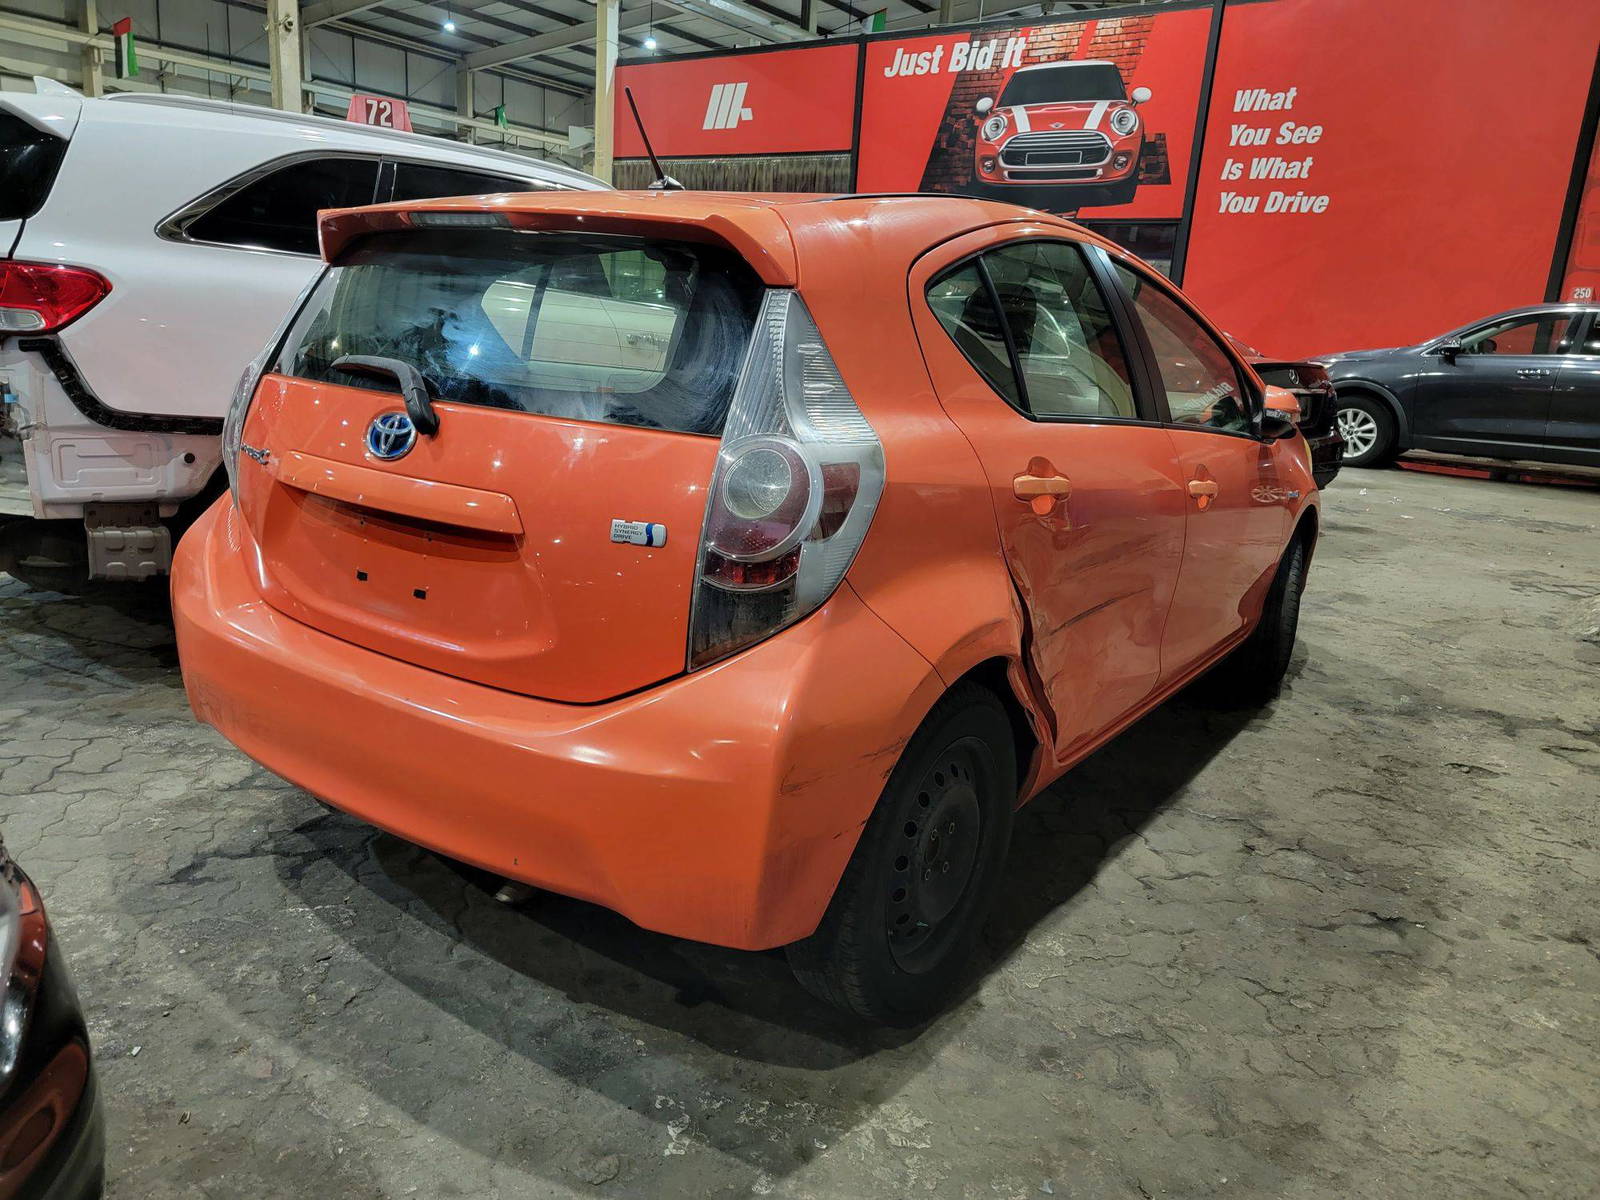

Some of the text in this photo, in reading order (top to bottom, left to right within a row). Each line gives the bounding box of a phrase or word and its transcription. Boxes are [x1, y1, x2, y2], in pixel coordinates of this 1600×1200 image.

[884, 36, 1027, 78] Just Bid It
[1233, 87, 1297, 112] What
[366, 99, 392, 127] 72
[1229, 121, 1323, 147] You See
[1220, 157, 1313, 180] Is What
[1218, 191, 1330, 213] You Drive
[1573, 287, 1592, 299] 250
[614, 523, 639, 531] HYBRID
